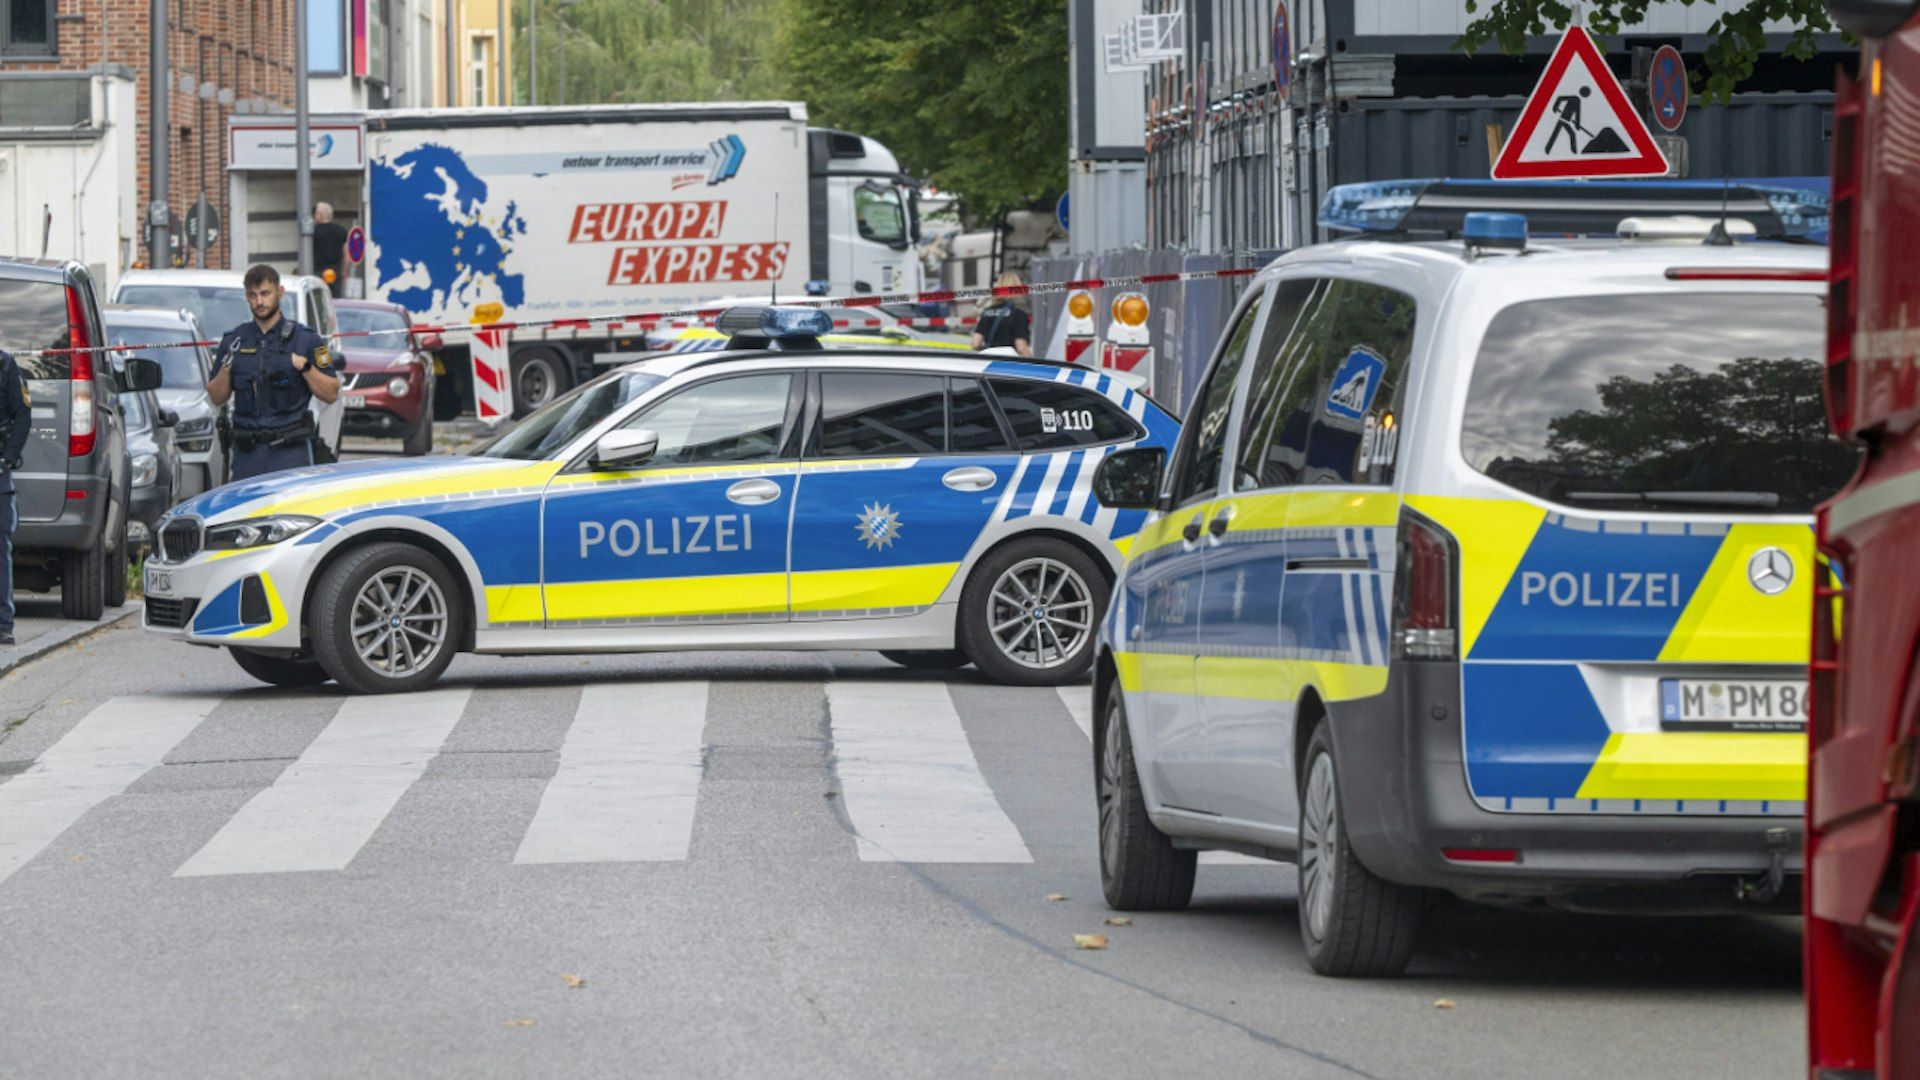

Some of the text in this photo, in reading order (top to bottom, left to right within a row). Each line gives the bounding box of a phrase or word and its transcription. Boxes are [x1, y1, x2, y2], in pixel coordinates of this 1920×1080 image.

[562, 152, 706, 168] ontour transport service
[573, 201, 721, 242] EUROPA
[612, 243, 788, 285] EXPRESS
[1062, 409, 1094, 431] 110
[579, 513, 752, 559] POLIZEI
[1521, 571, 1680, 607] POLIZEI
[1682, 684, 1705, 717] M
[1727, 684, 1772, 717] PM
